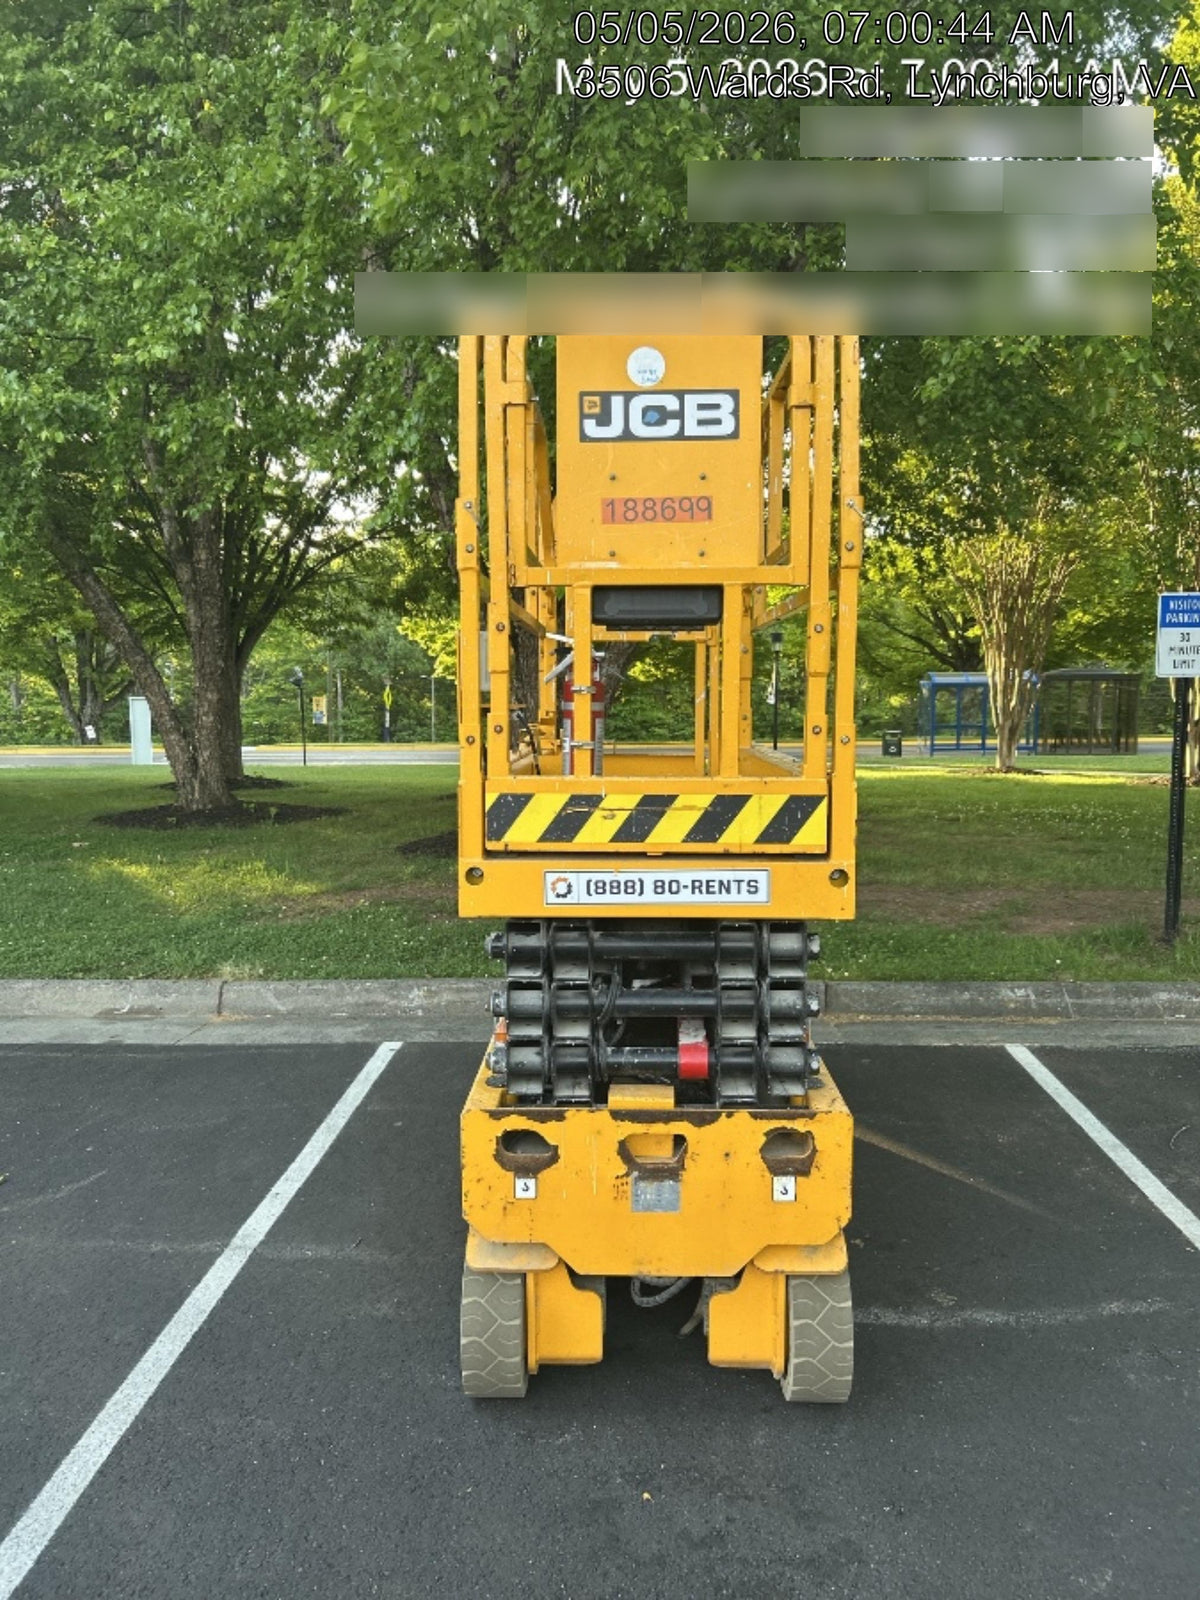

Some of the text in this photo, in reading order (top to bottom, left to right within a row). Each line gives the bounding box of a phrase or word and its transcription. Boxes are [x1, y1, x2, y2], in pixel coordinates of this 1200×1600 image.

[583, 394, 735, 438] JCB
[605, 496, 712, 522] 188699
[1166, 612, 1200, 623] PARKIN
[1173, 659, 1196, 669] LIMIT
[586, 878, 644, 897] (888)
